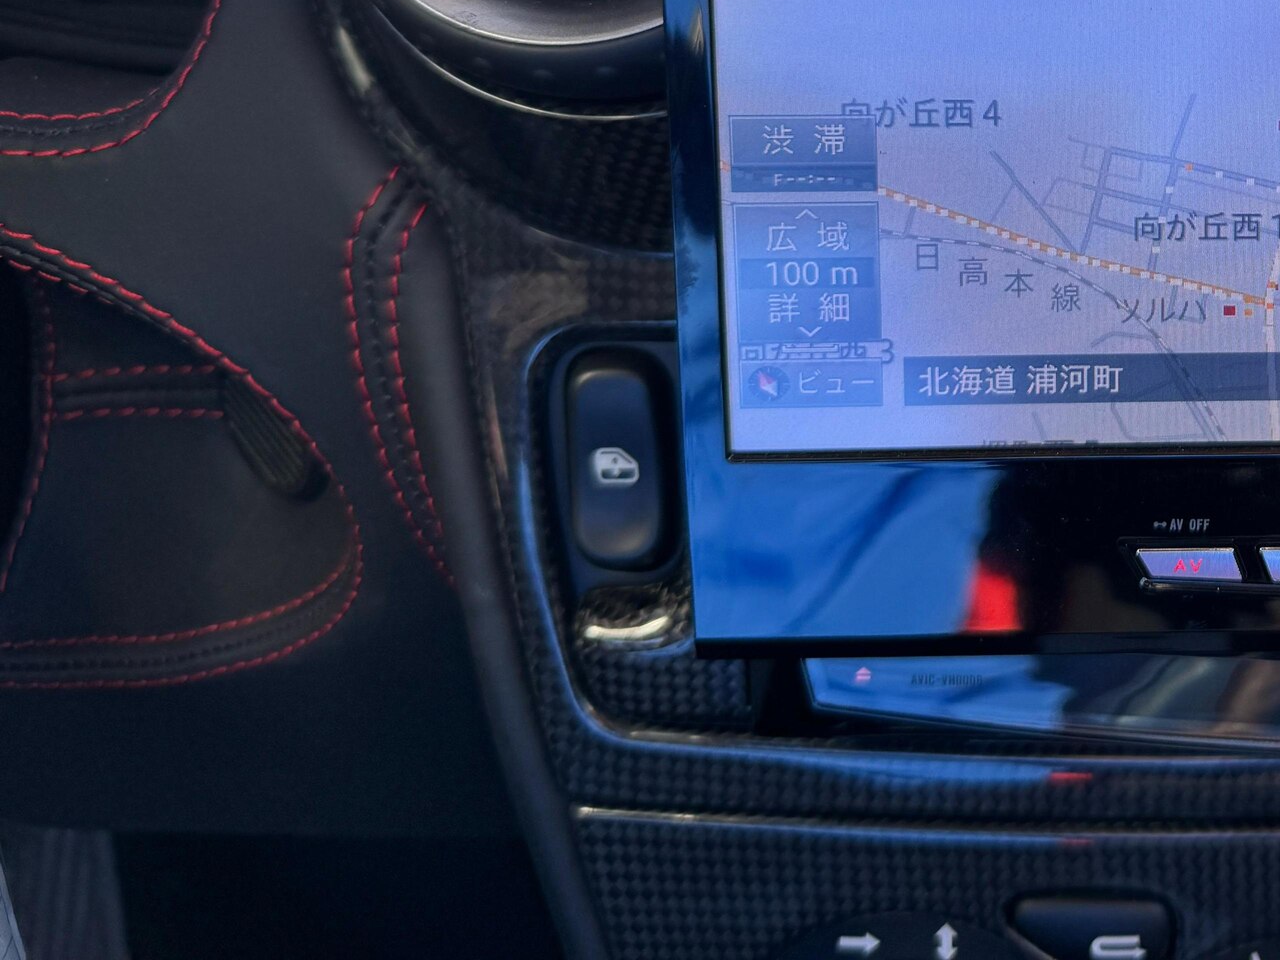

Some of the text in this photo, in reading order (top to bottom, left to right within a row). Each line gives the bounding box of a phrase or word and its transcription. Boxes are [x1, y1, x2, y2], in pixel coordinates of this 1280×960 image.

[766, 261, 820, 287] 100
[799, 369, 874, 394] ビュー
[919, 363, 1123, 396] 北海道 浦河町
[1169, 518, 1210, 531] AV OFF
[1172, 558, 1203, 574] AV
